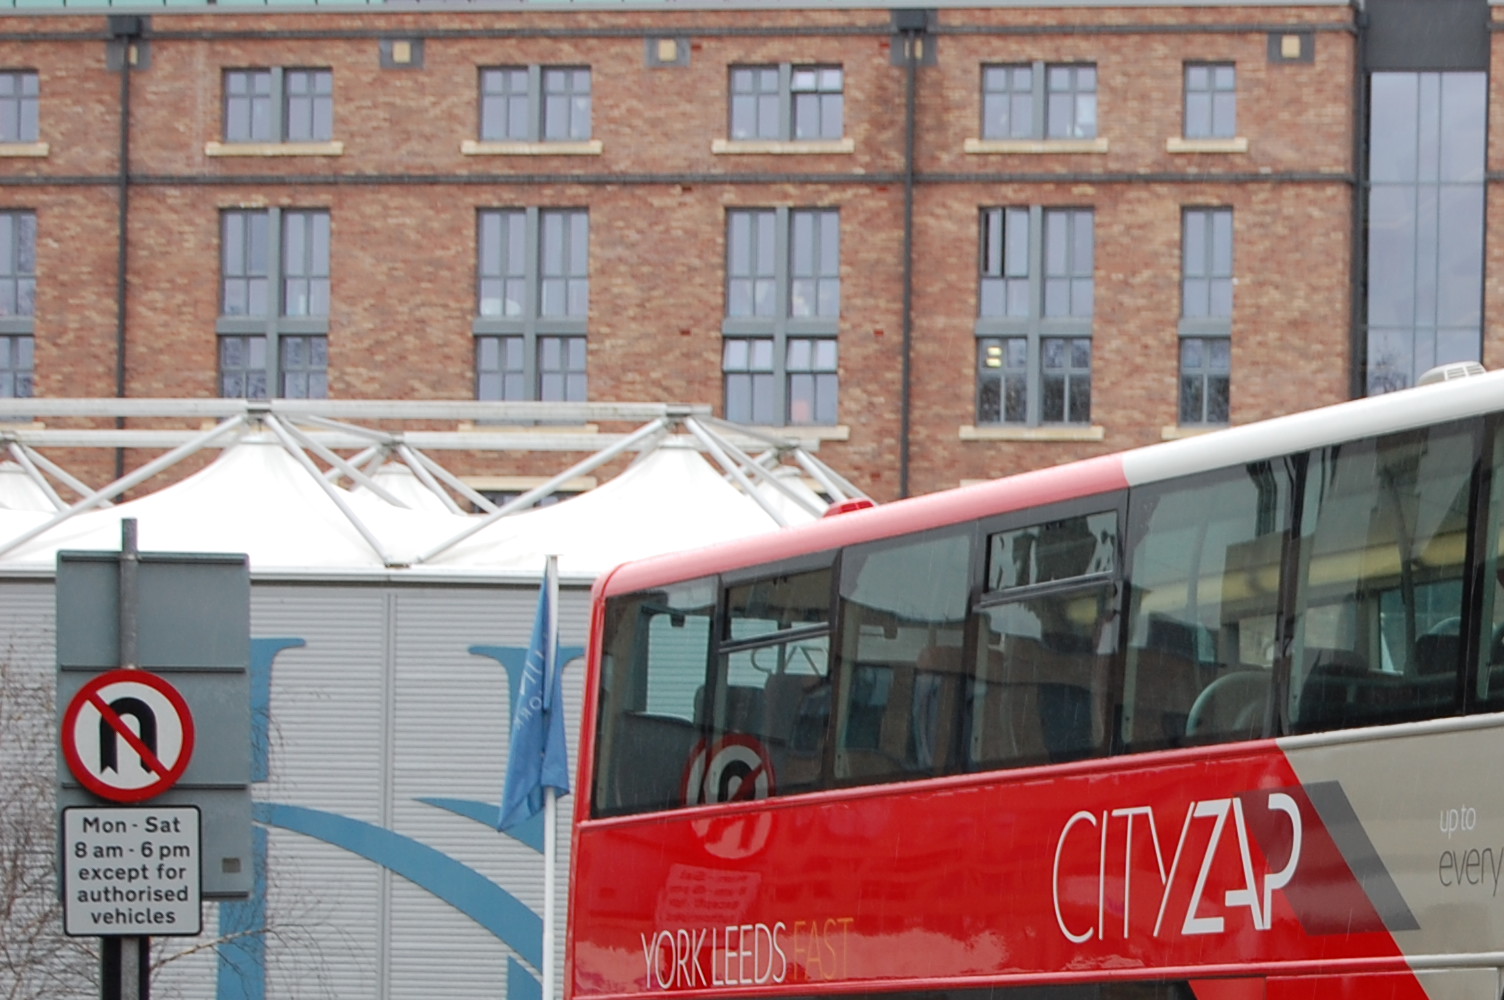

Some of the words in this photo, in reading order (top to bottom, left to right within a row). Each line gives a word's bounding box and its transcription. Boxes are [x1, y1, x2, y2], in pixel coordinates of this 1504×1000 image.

[82, 816, 127, 833] Mon
[144, 816, 181, 833] Sat
[74, 841, 88, 858] 8
[93, 844, 123, 858] am
[141, 840, 154, 858] 6
[159, 844, 190, 860] pm
[78, 864, 149, 883] except
[157, 863, 186, 879] for
[1438, 846, 1504, 897] every
[77, 885, 189, 902] authorised
[90, 907, 177, 924] vehicles
[640, 927, 708, 990] YORK
[711, 920, 788, 986] LEEDS
[793, 916, 855, 983] FAST
